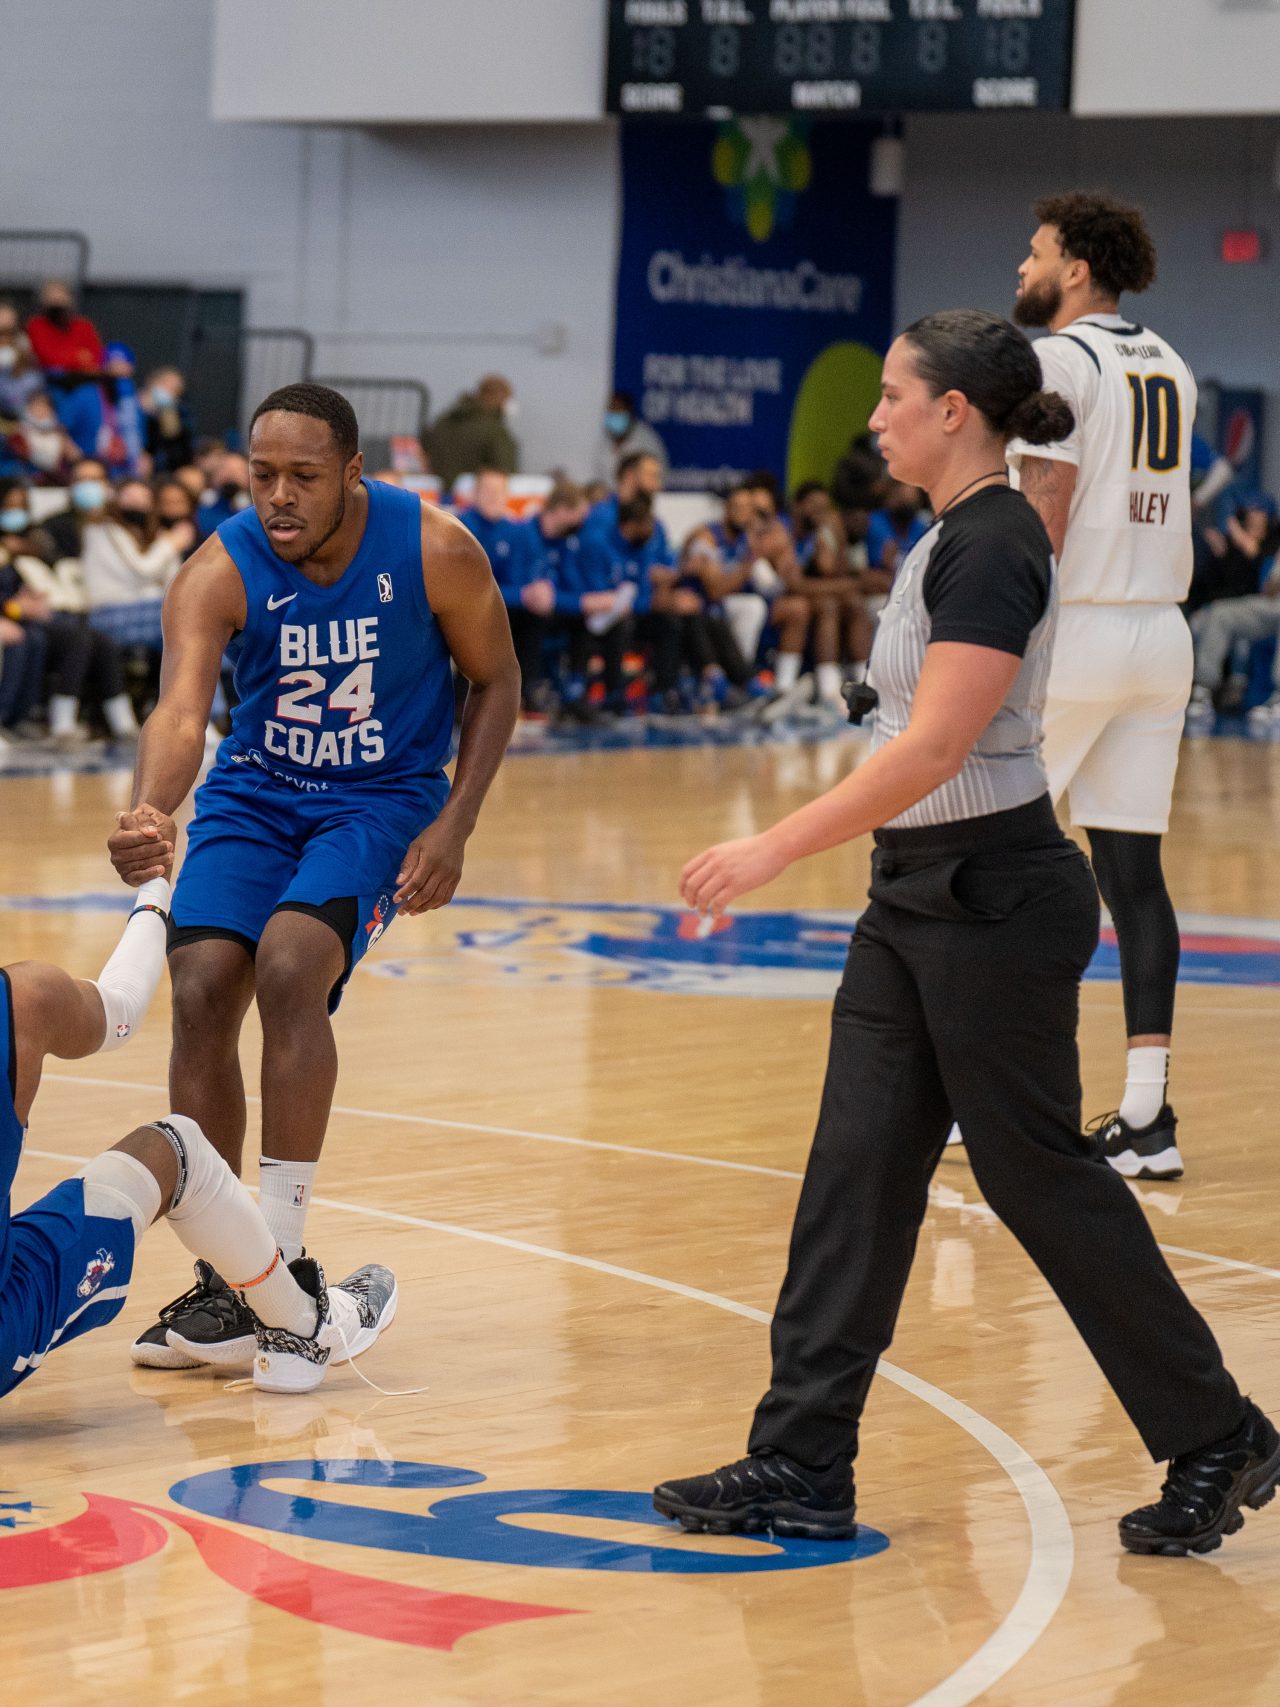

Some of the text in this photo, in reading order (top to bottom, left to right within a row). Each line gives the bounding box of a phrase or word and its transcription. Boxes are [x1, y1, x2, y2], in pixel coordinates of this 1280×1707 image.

[647, 250, 862, 314] ChristianaCare
[1126, 371, 1182, 474] 10
[1129, 490, 1170, 526] HALEY
[280, 617, 380, 666] BLUE
[276, 662, 375, 725] 24
[264, 719, 386, 768] COATS
